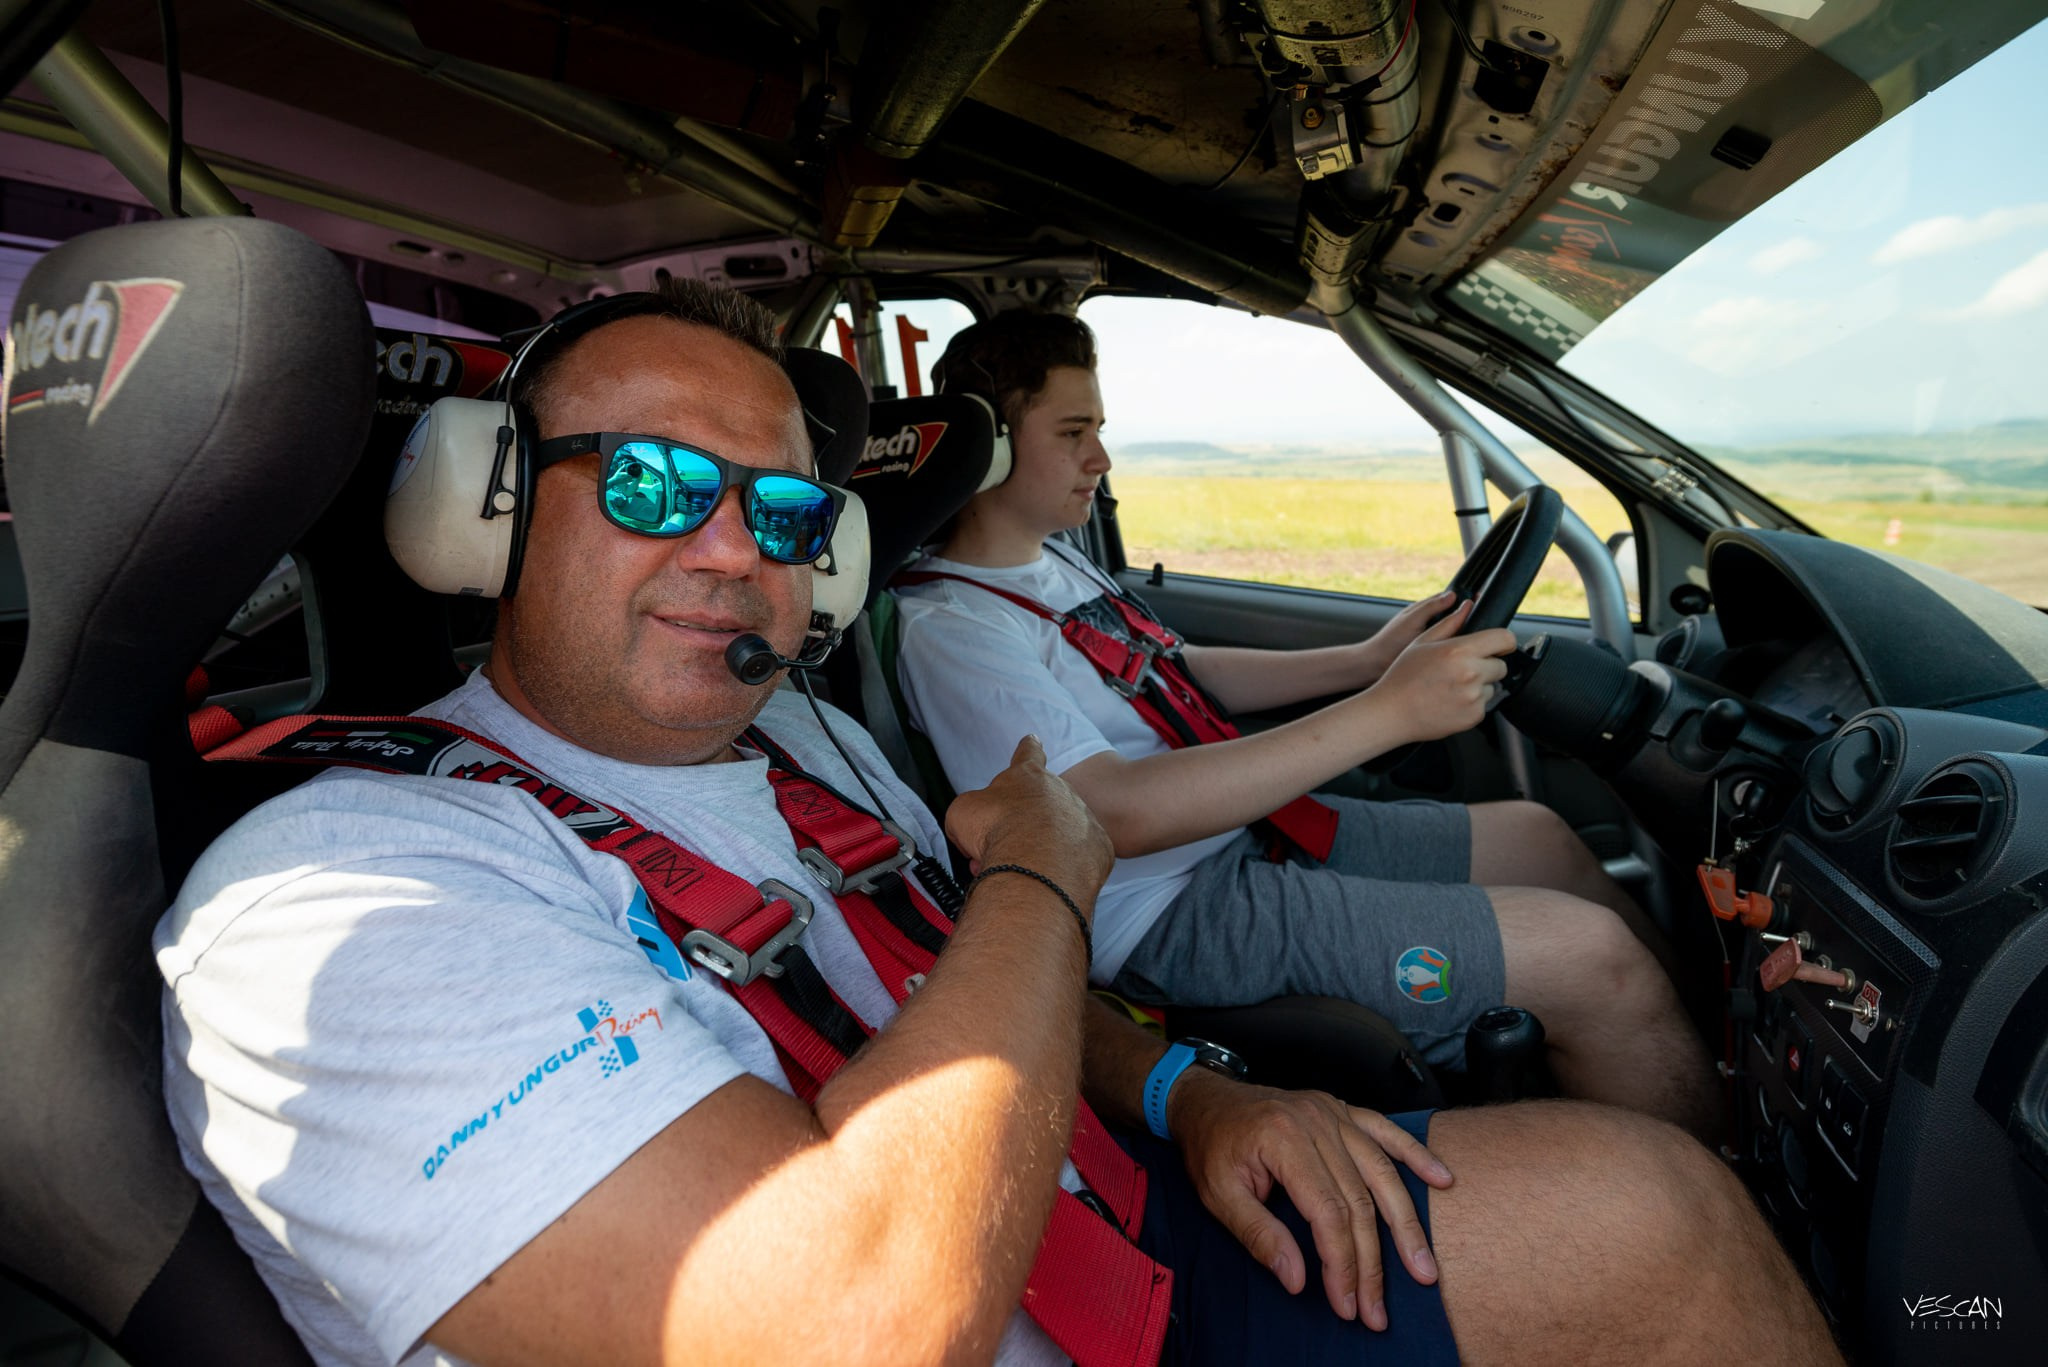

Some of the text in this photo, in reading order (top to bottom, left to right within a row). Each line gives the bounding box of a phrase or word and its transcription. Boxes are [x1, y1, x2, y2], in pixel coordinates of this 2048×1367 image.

[881, 461, 910, 473] racing
[343, 738, 415, 757] Safety
[1864, 986, 1879, 1005] ON
